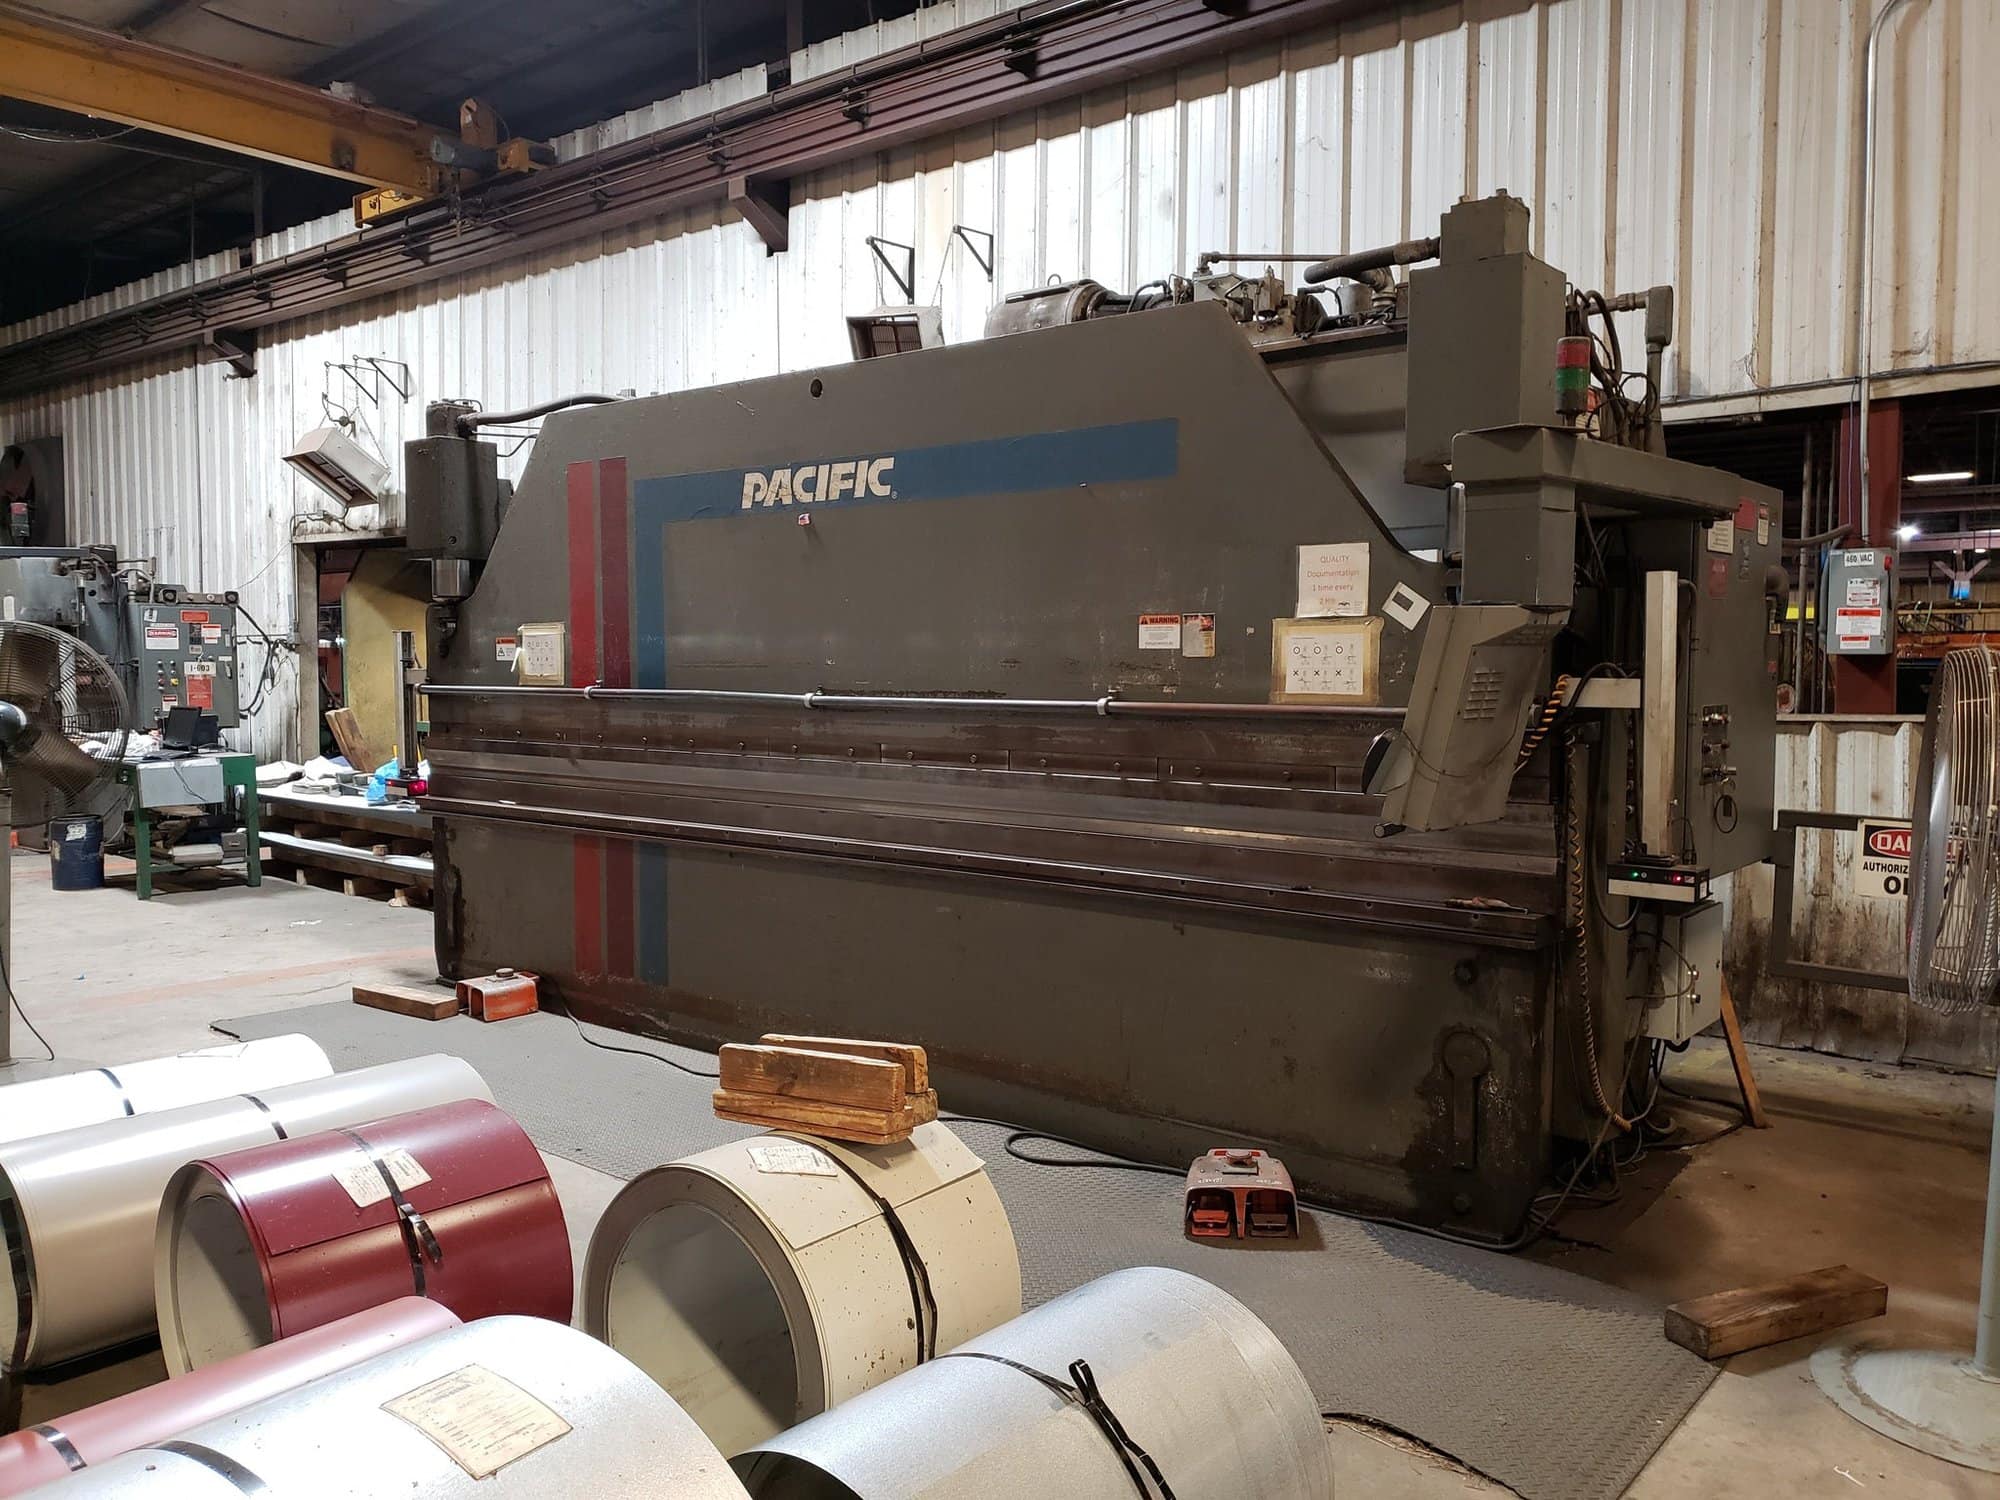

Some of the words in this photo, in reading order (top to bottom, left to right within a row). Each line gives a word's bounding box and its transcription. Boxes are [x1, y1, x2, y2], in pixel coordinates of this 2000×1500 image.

[742, 457, 895, 509] PACIFIC
[1320, 554, 1350, 563] QUALITY
[1307, 568, 1360, 578] Documentation
[1318, 583, 1333, 591] time
[1149, 616, 1179, 624] WARNING
[1863, 861, 1909, 875] AUTHORIZ
